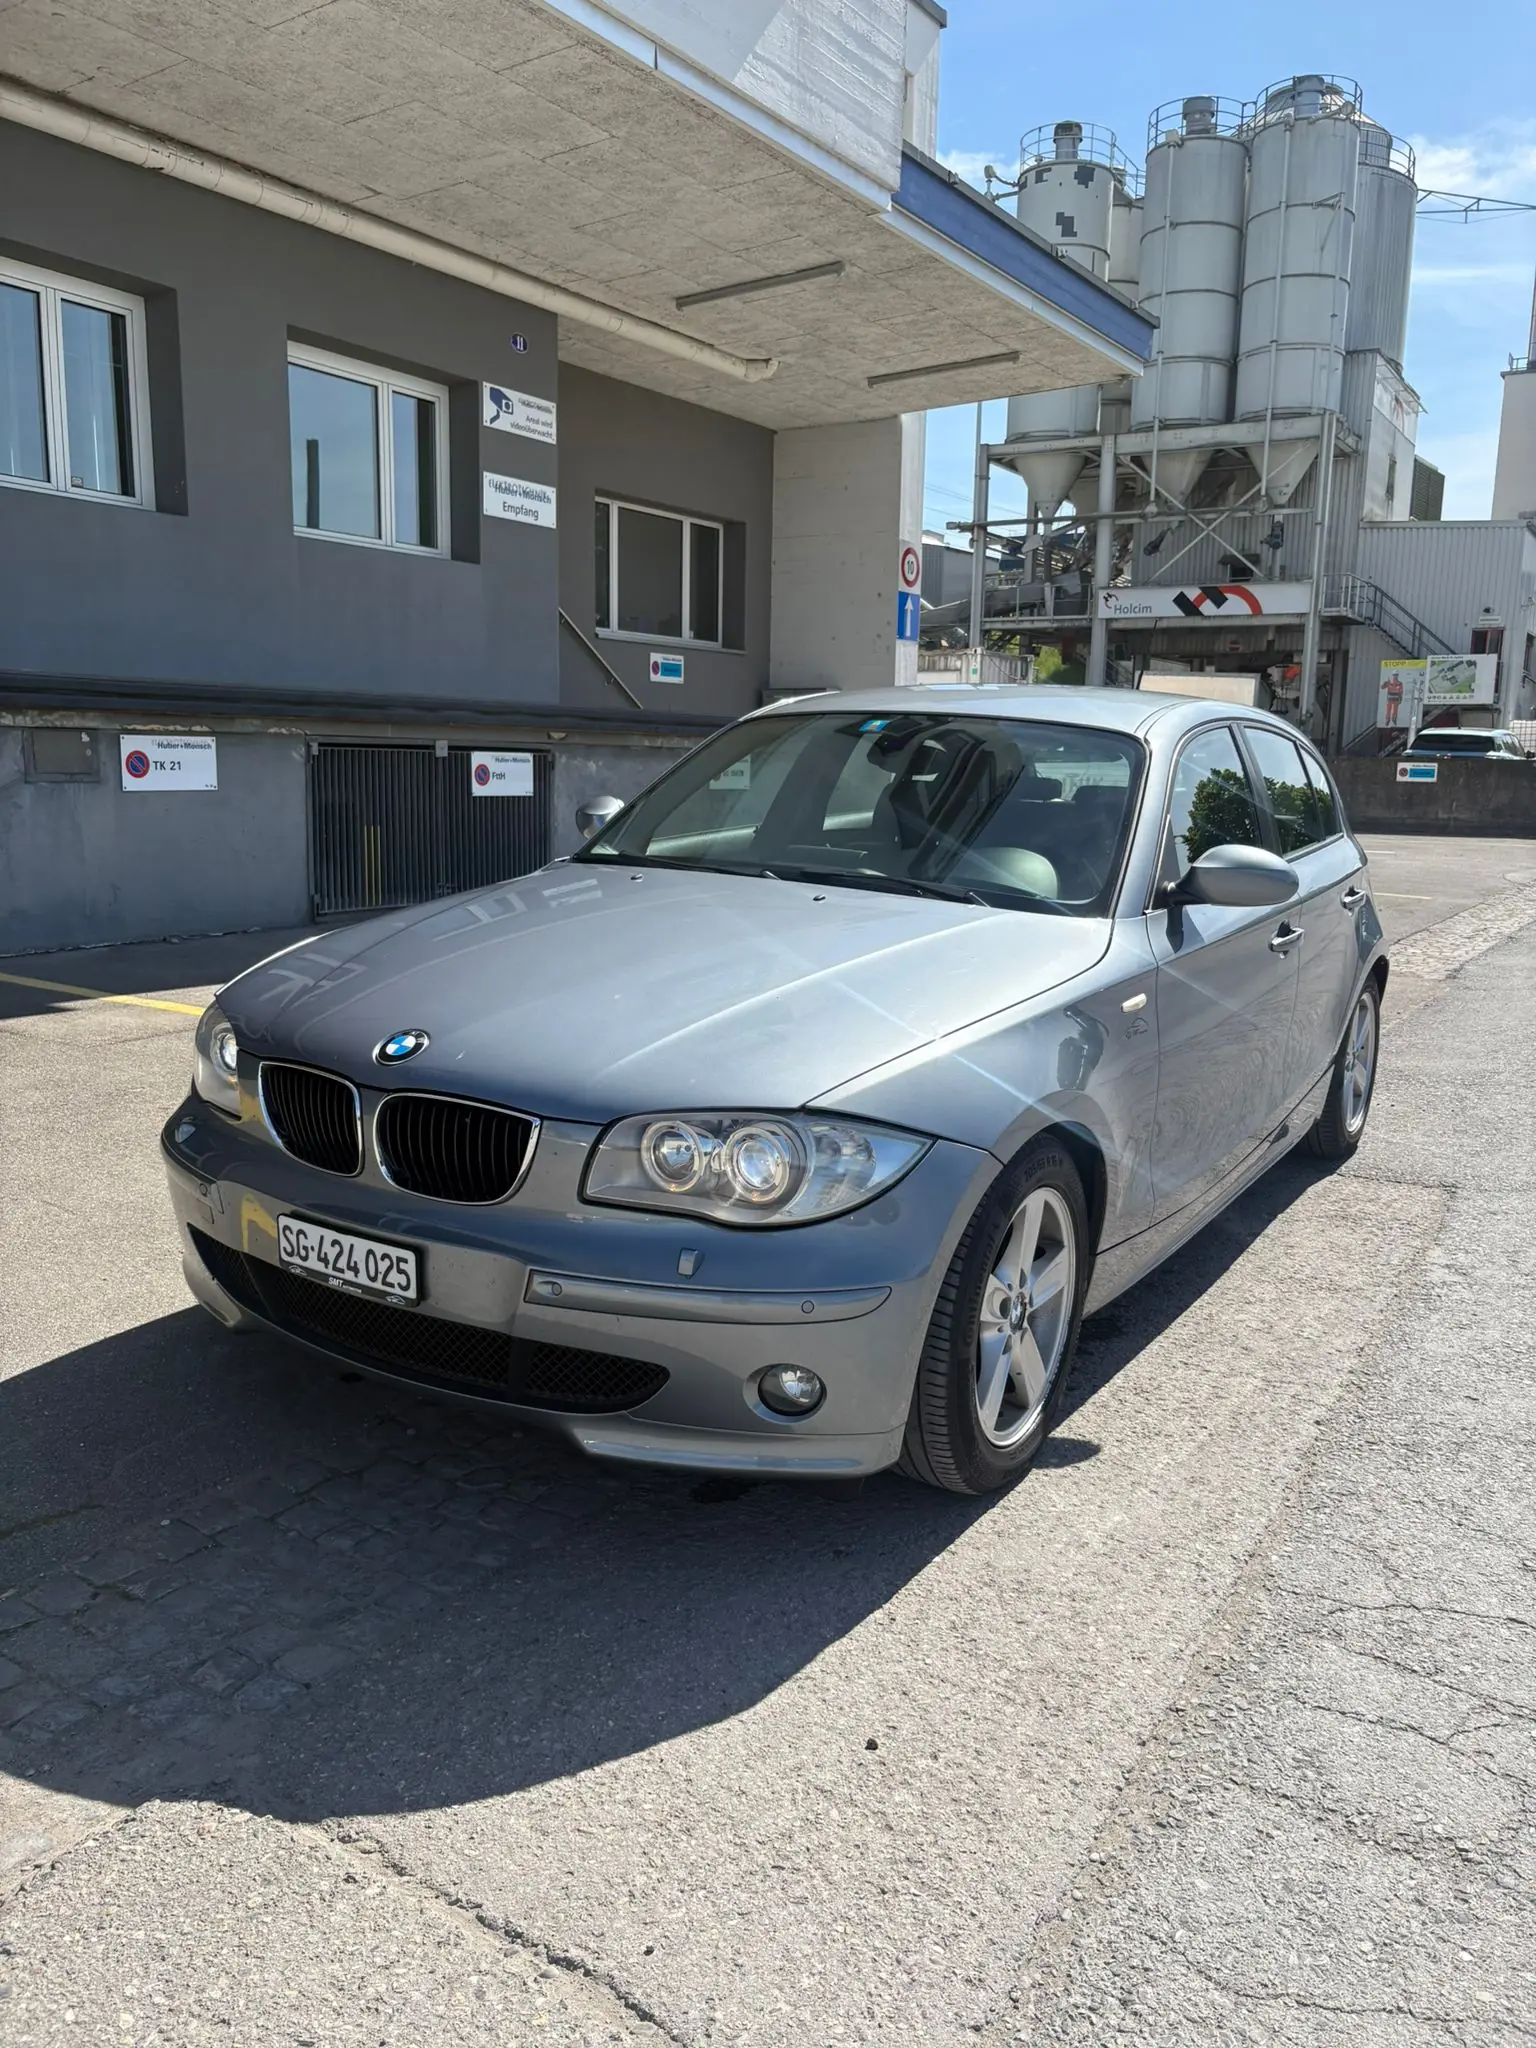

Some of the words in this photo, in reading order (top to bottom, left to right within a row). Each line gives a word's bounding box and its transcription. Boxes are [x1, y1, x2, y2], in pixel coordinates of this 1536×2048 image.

[516, 335, 525, 351] 11
[502, 500, 539, 521] Empfang
[907, 559, 915, 575] 10
[1113, 603, 1152, 615] Holcim
[152, 760, 167, 771] TK
[169, 761, 181, 771] 21
